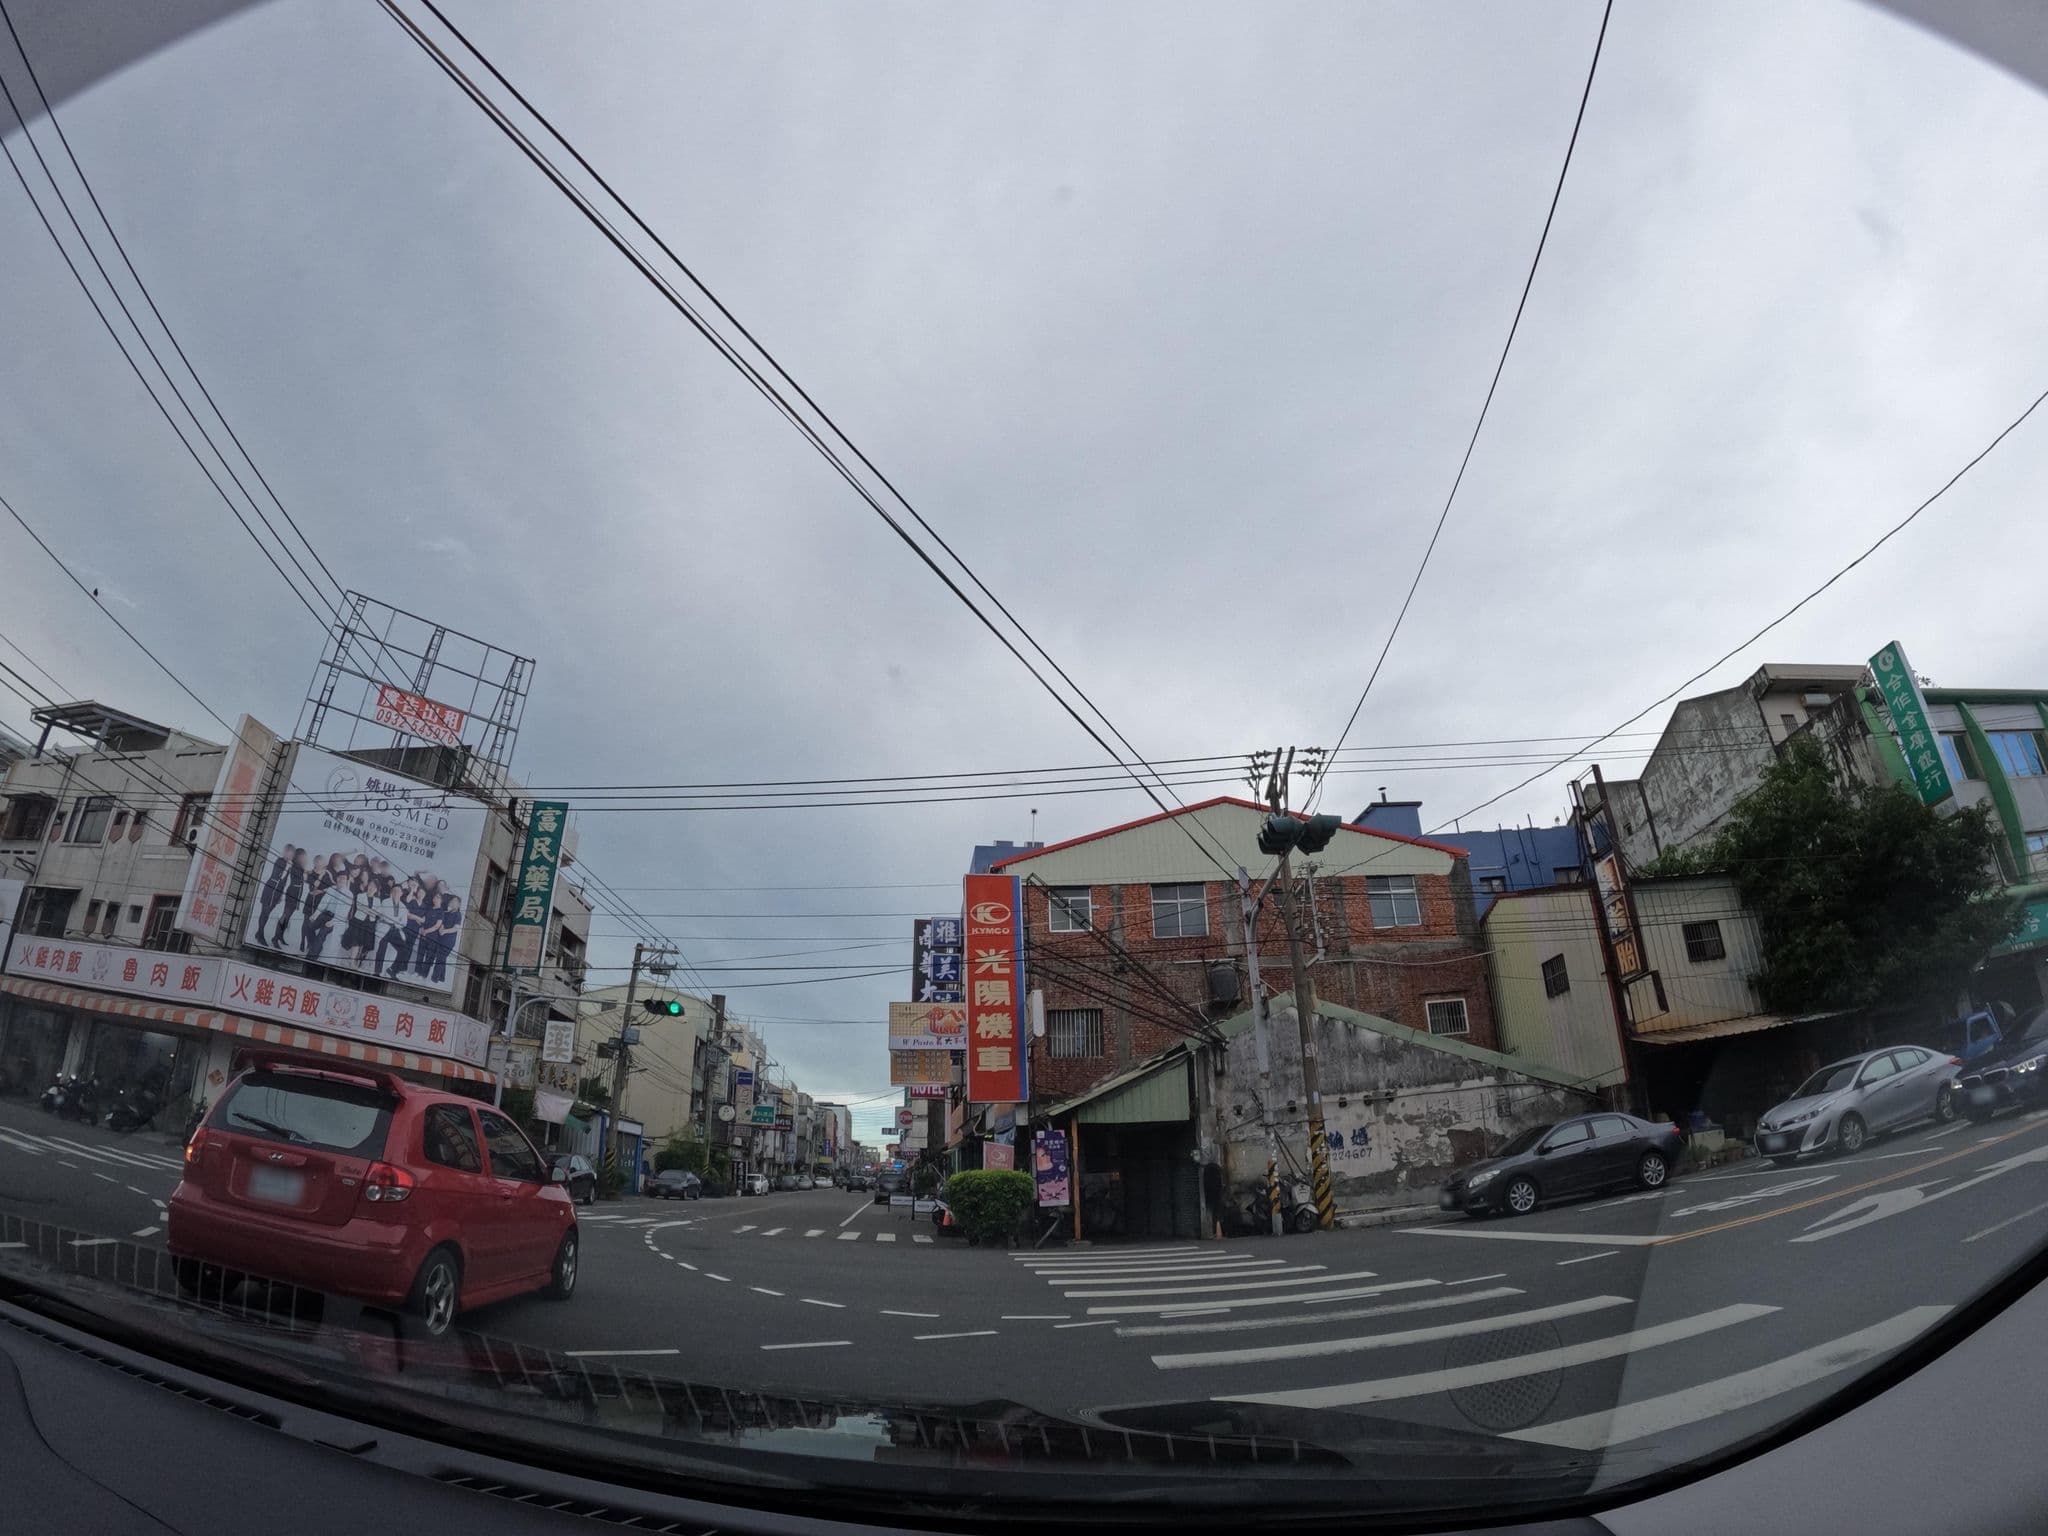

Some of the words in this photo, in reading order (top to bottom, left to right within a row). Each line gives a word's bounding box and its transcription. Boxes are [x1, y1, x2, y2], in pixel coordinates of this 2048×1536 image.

[376, 708, 406, 729] 0932
[380, 687, 460, 732] 廣告出租
[1885, 673, 1942, 791] 合作金庫銀行
[363, 794, 449, 831] YOSMED
[516, 806, 563, 924] 富民藥局
[971, 927, 1010, 935] KYMCO
[18, 943, 83, 974] 火雞肉飯
[122, 957, 202, 993] 魯肉飯
[229, 973, 321, 1018] 火雞肉飯
[973, 948, 1013, 1073] 光陽機車
[361, 1004, 448, 1045] 魯肉飯
[912, 1084, 945, 1095] HOTEL
